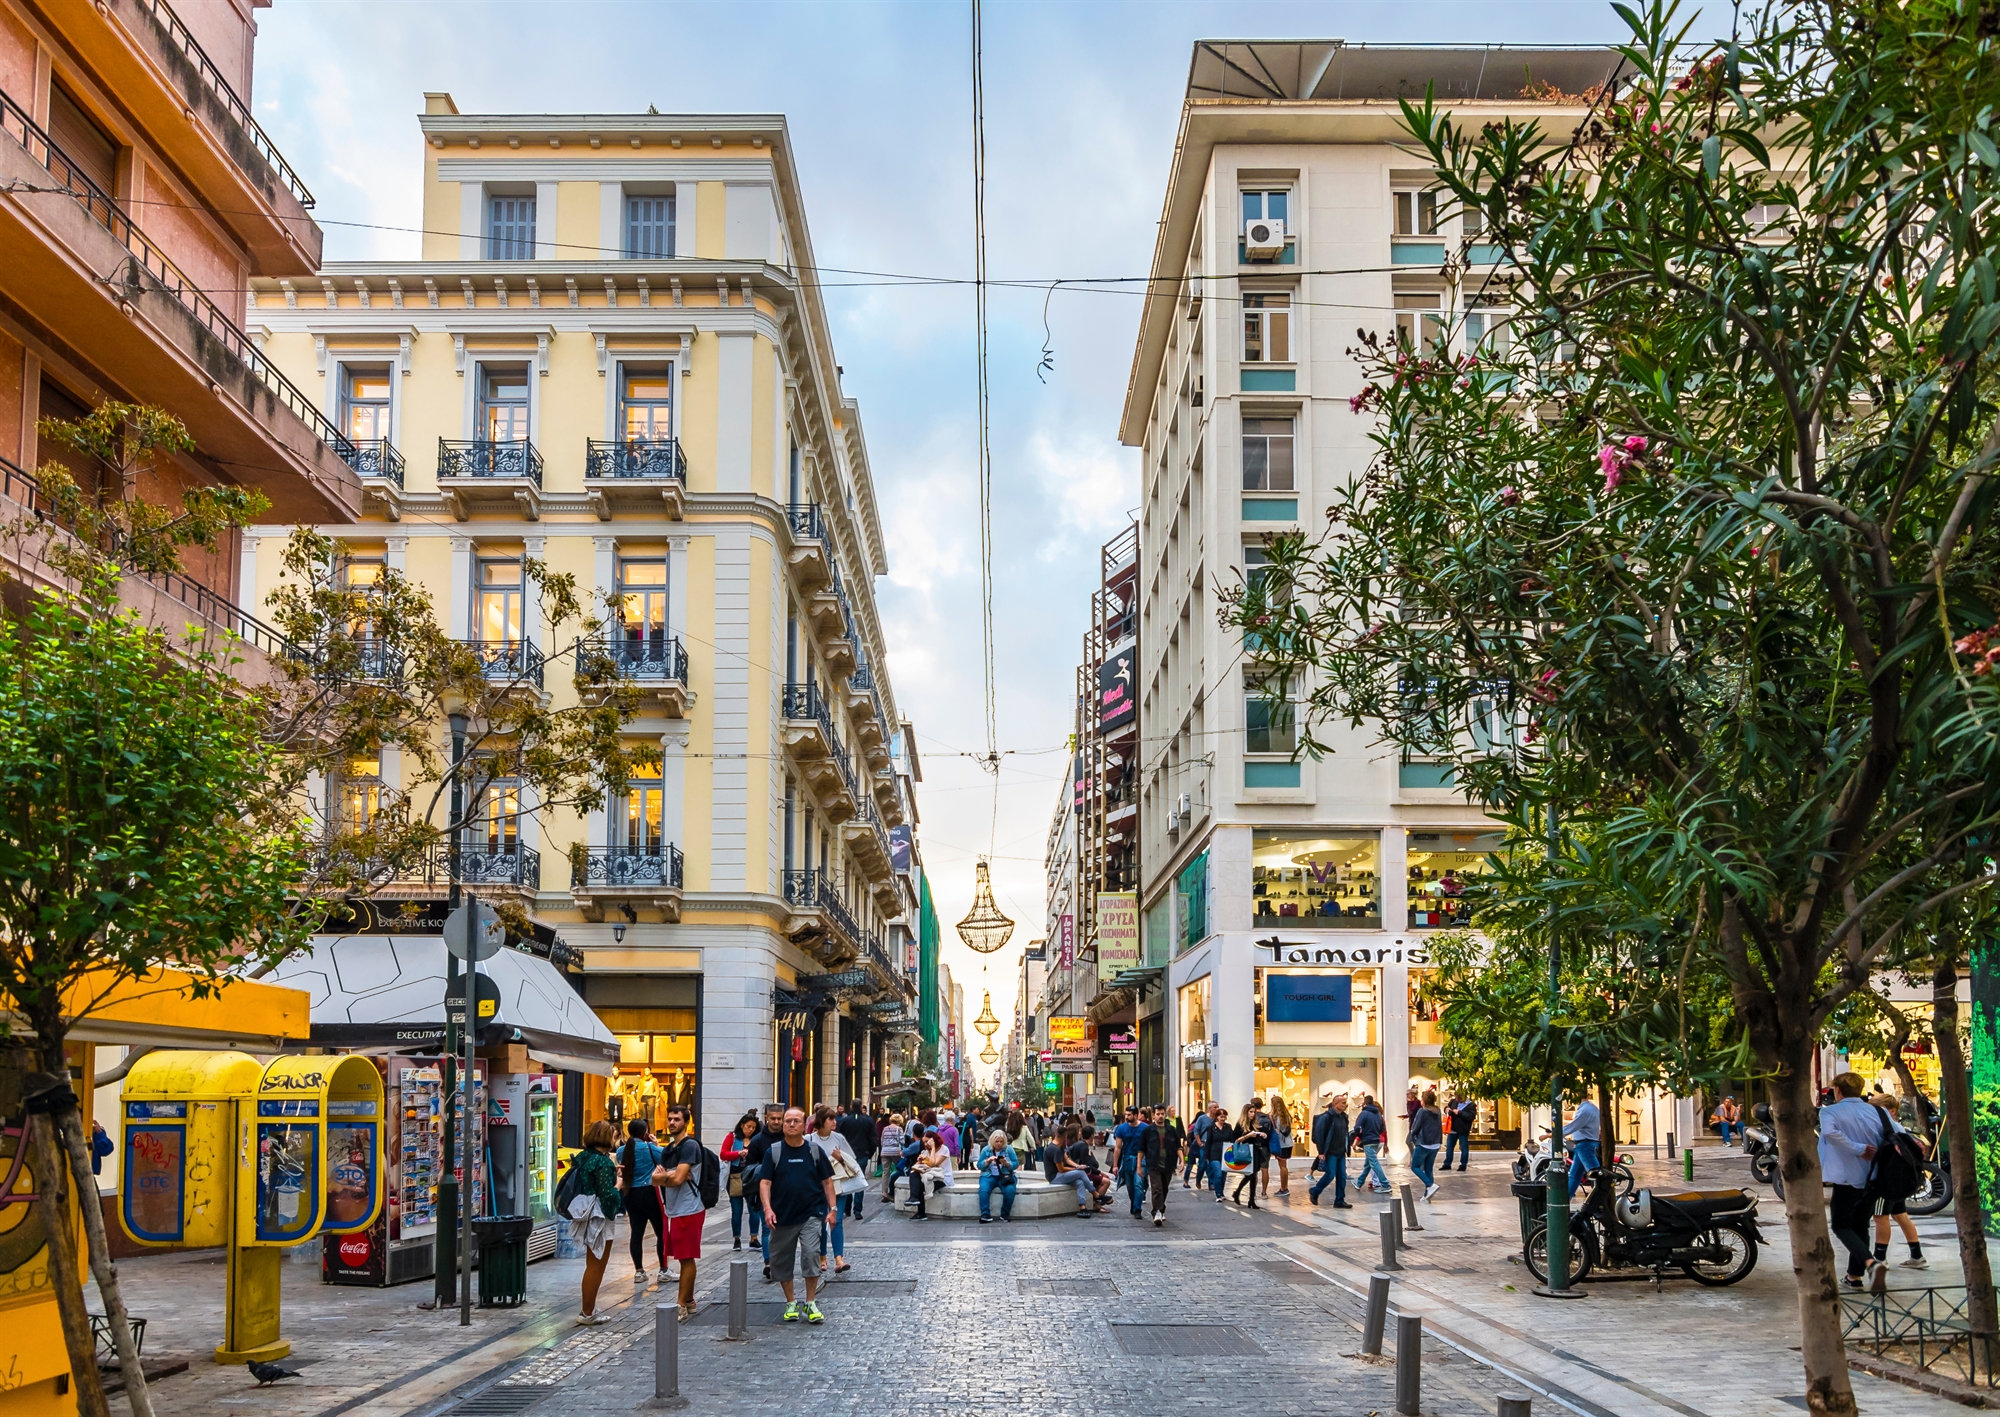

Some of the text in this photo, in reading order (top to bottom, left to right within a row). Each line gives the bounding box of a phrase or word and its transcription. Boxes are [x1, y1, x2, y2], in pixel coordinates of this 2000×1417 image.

[1099, 899, 1137, 909] ΑΓΟΡΑΖΟΝΤΑΙ
[1102, 912, 1135, 926] ΧΡΥΣΑ
[1100, 928, 1137, 938] ΚΟΣΜΗΜΑΤΑ
[1100, 949, 1137, 959] ΝΟΜΙΣΜΑΤΑ
[1254, 936, 1431, 965] tamaris
[1284, 994, 1336, 1002] TOUGH GIRL
[779, 1011, 807, 1031] H&M
